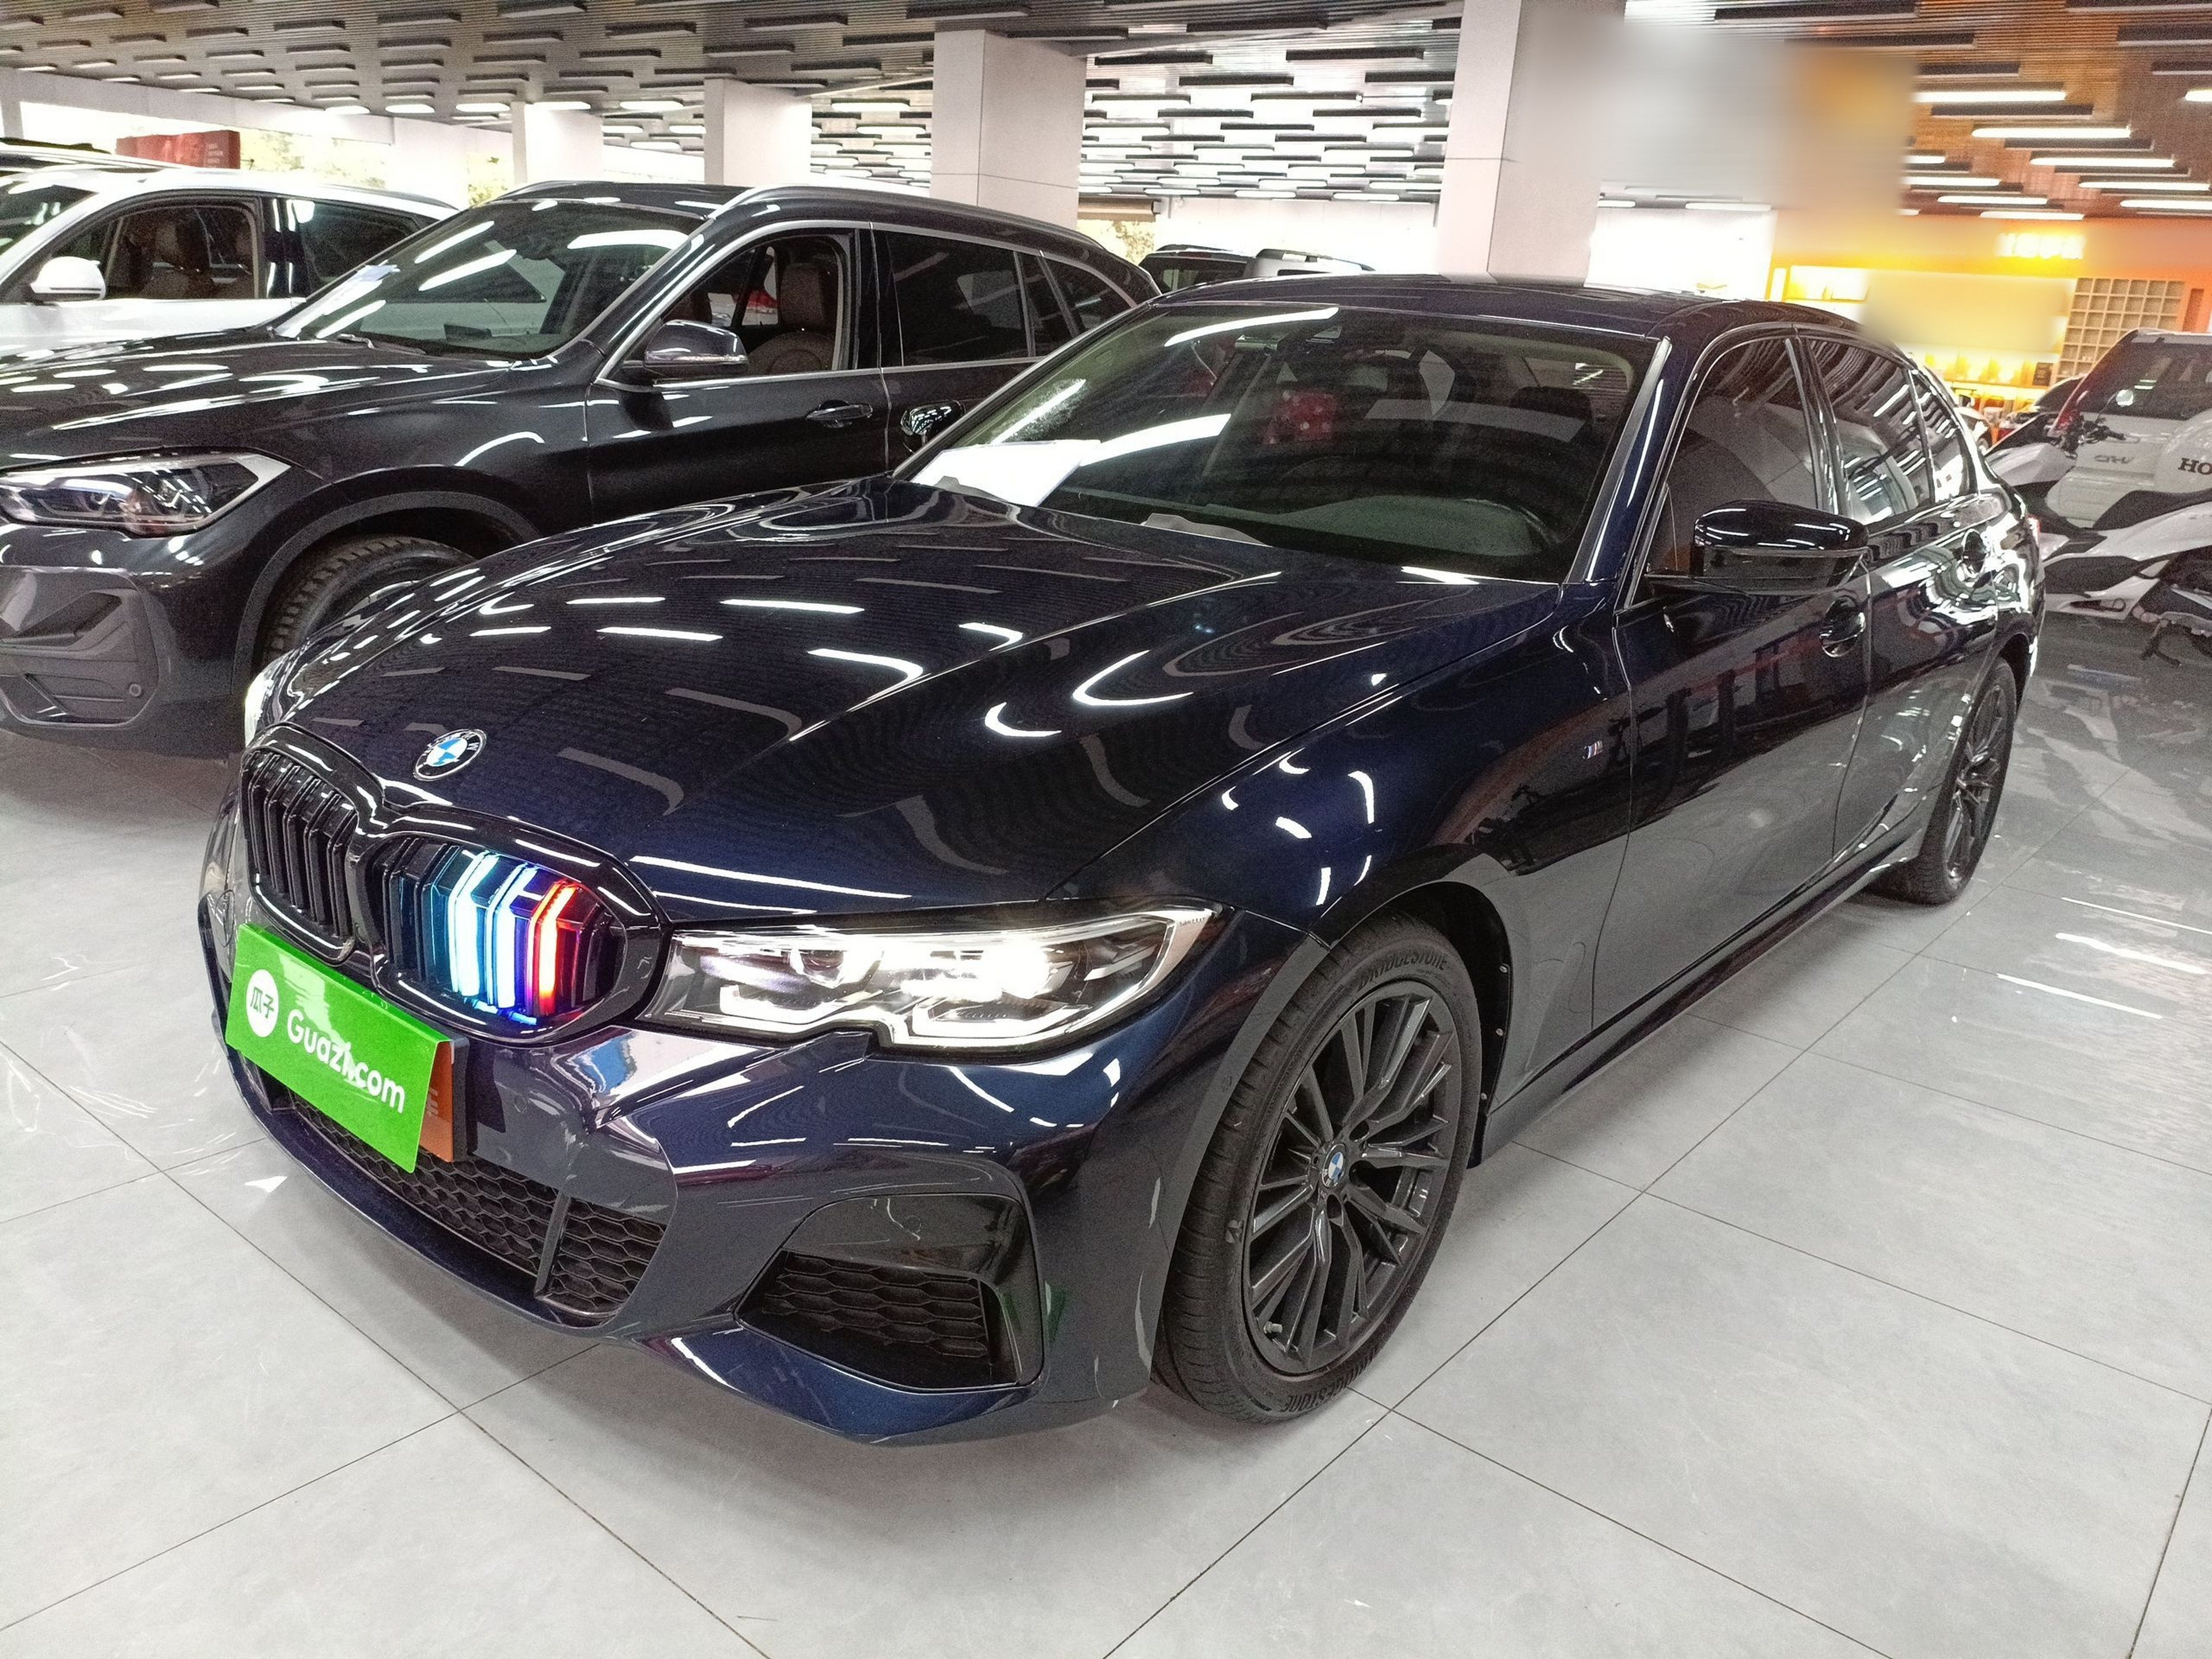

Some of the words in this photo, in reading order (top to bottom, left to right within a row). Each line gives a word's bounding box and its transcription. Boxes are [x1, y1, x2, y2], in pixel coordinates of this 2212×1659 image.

[2178, 458, 2212, 475] HO
[250, 986, 274, 1018] 瓜子
[287, 1009, 405, 1113] Guazi.com
